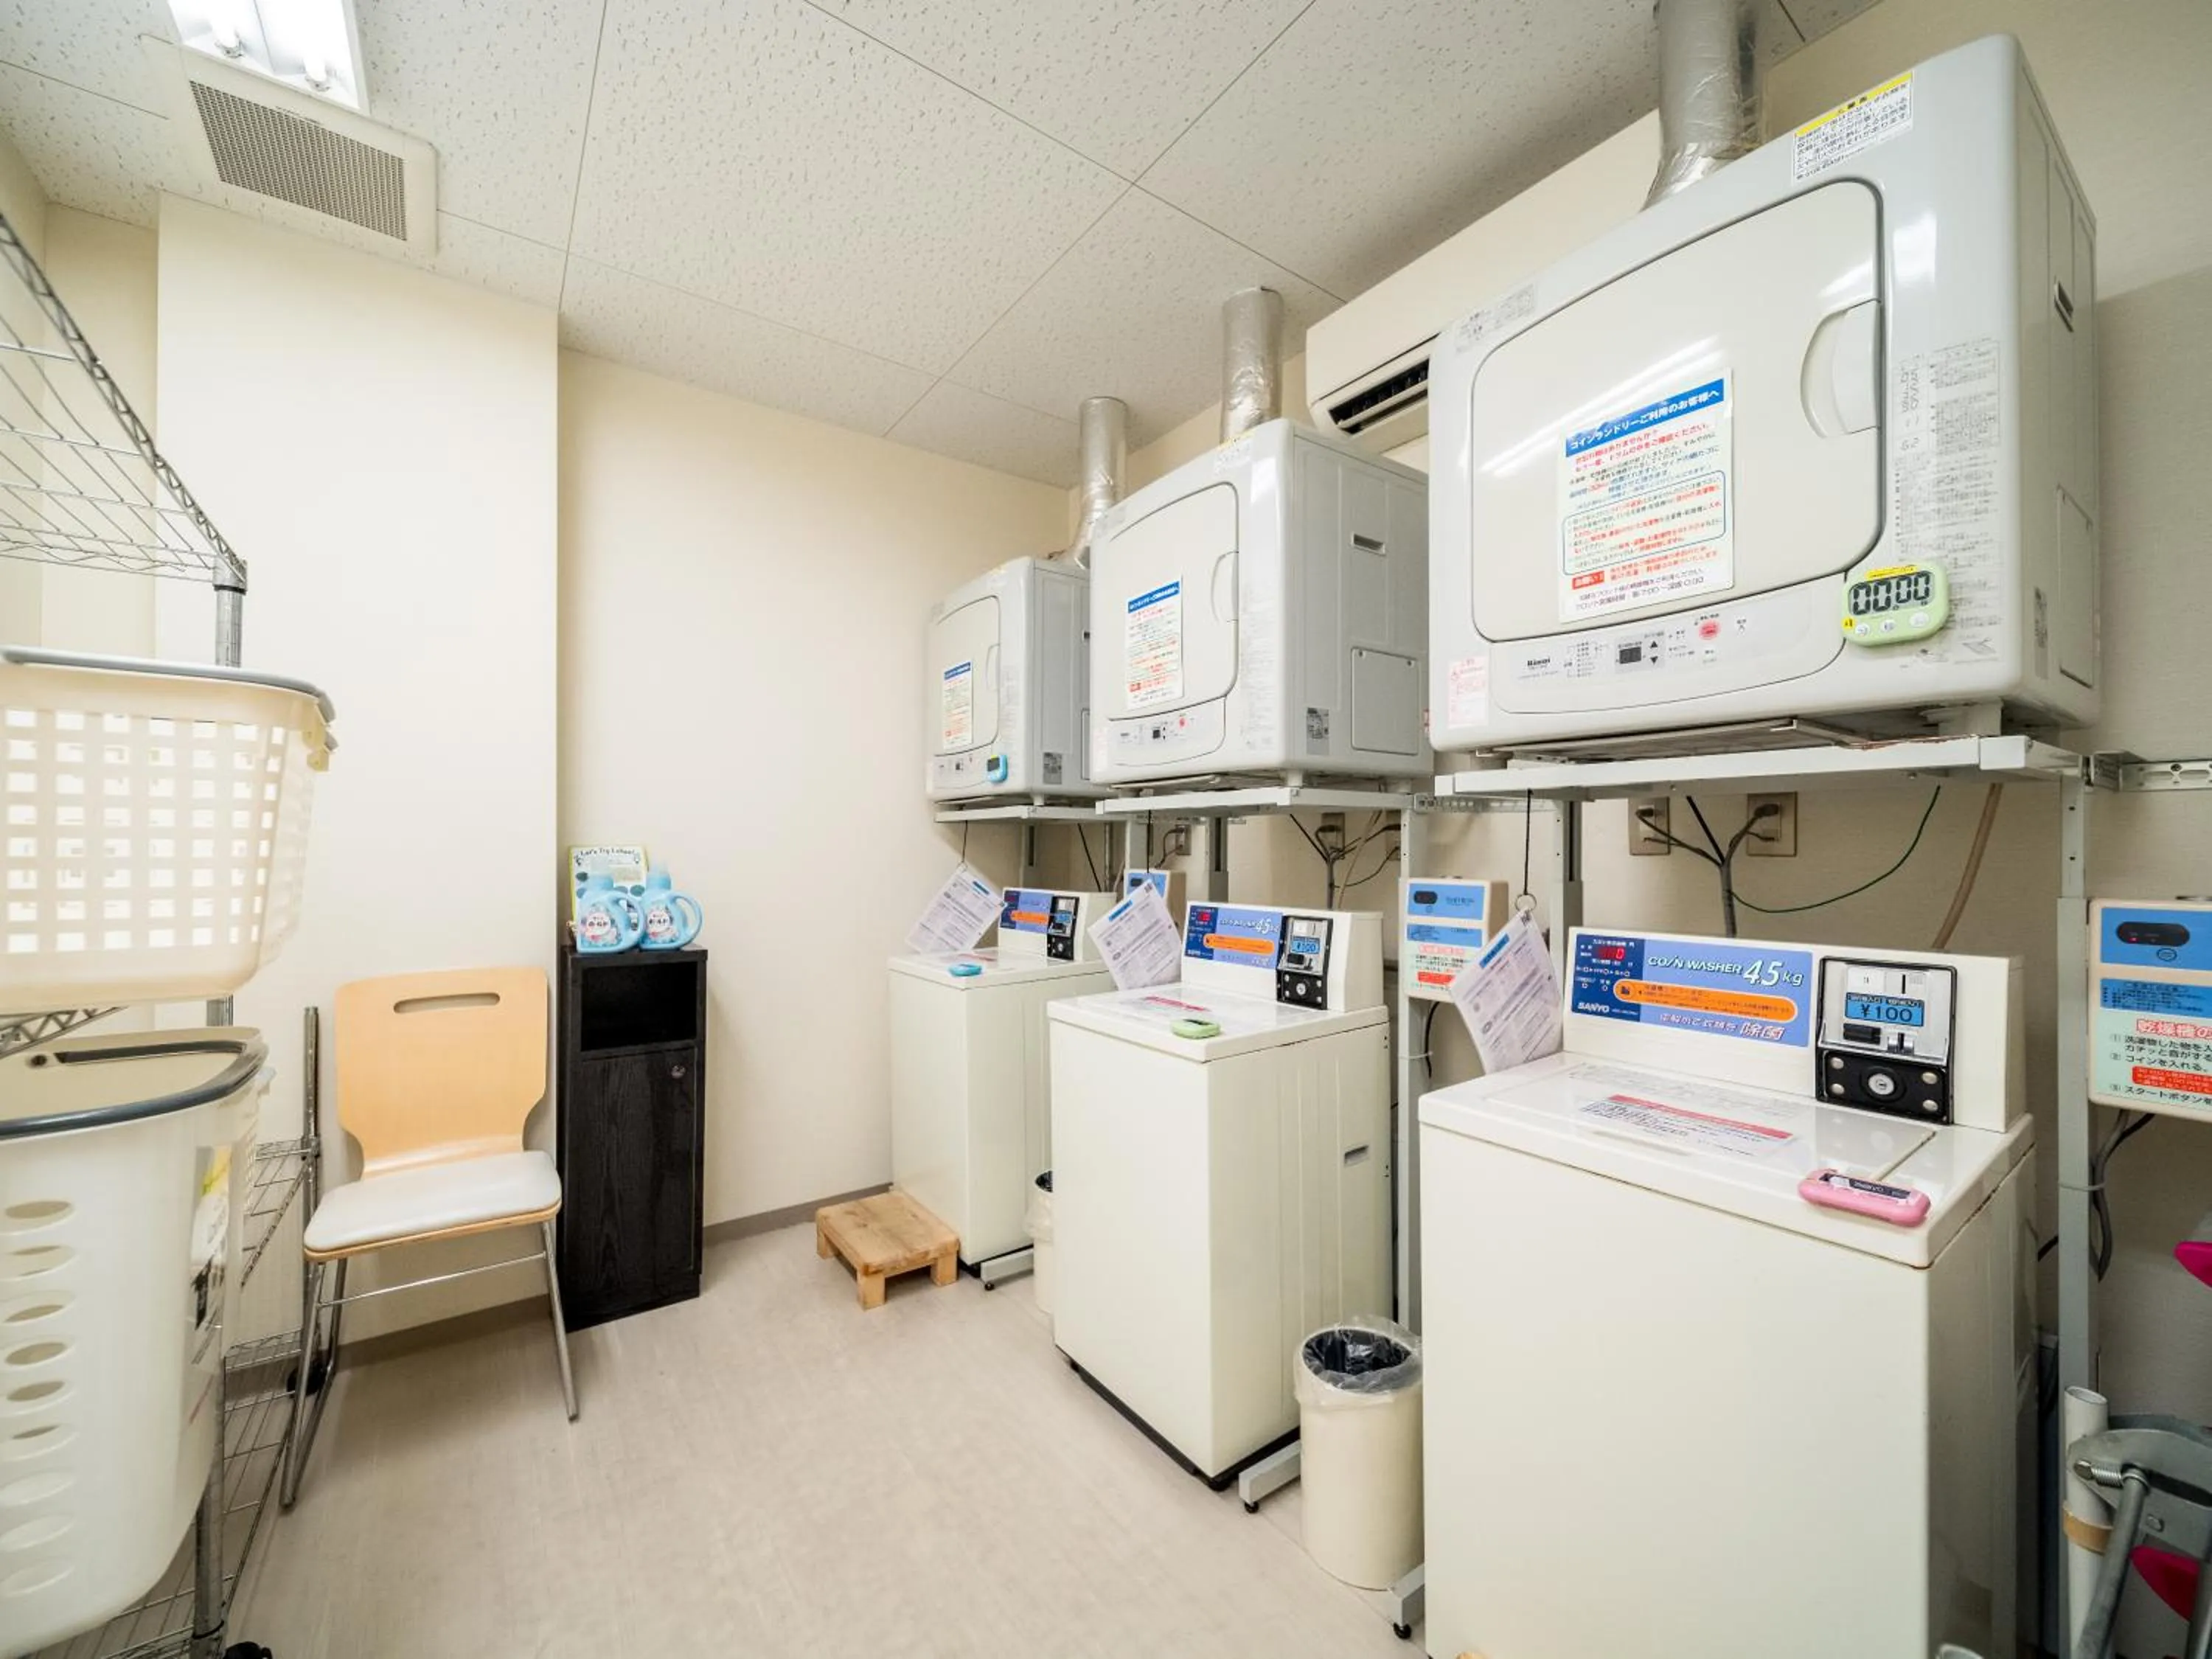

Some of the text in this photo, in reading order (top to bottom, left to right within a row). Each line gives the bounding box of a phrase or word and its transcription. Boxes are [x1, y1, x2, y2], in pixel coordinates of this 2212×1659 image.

[1647, 956, 1685, 969] COIN
[1688, 960, 1745, 975] WASHER
[1782, 970, 1804, 987] kg
[1578, 1001, 1610, 1014] SANYO
[1860, 1004, 1913, 1023] ¥100
[2136, 1018, 2212, 1040] 乾燥機の
